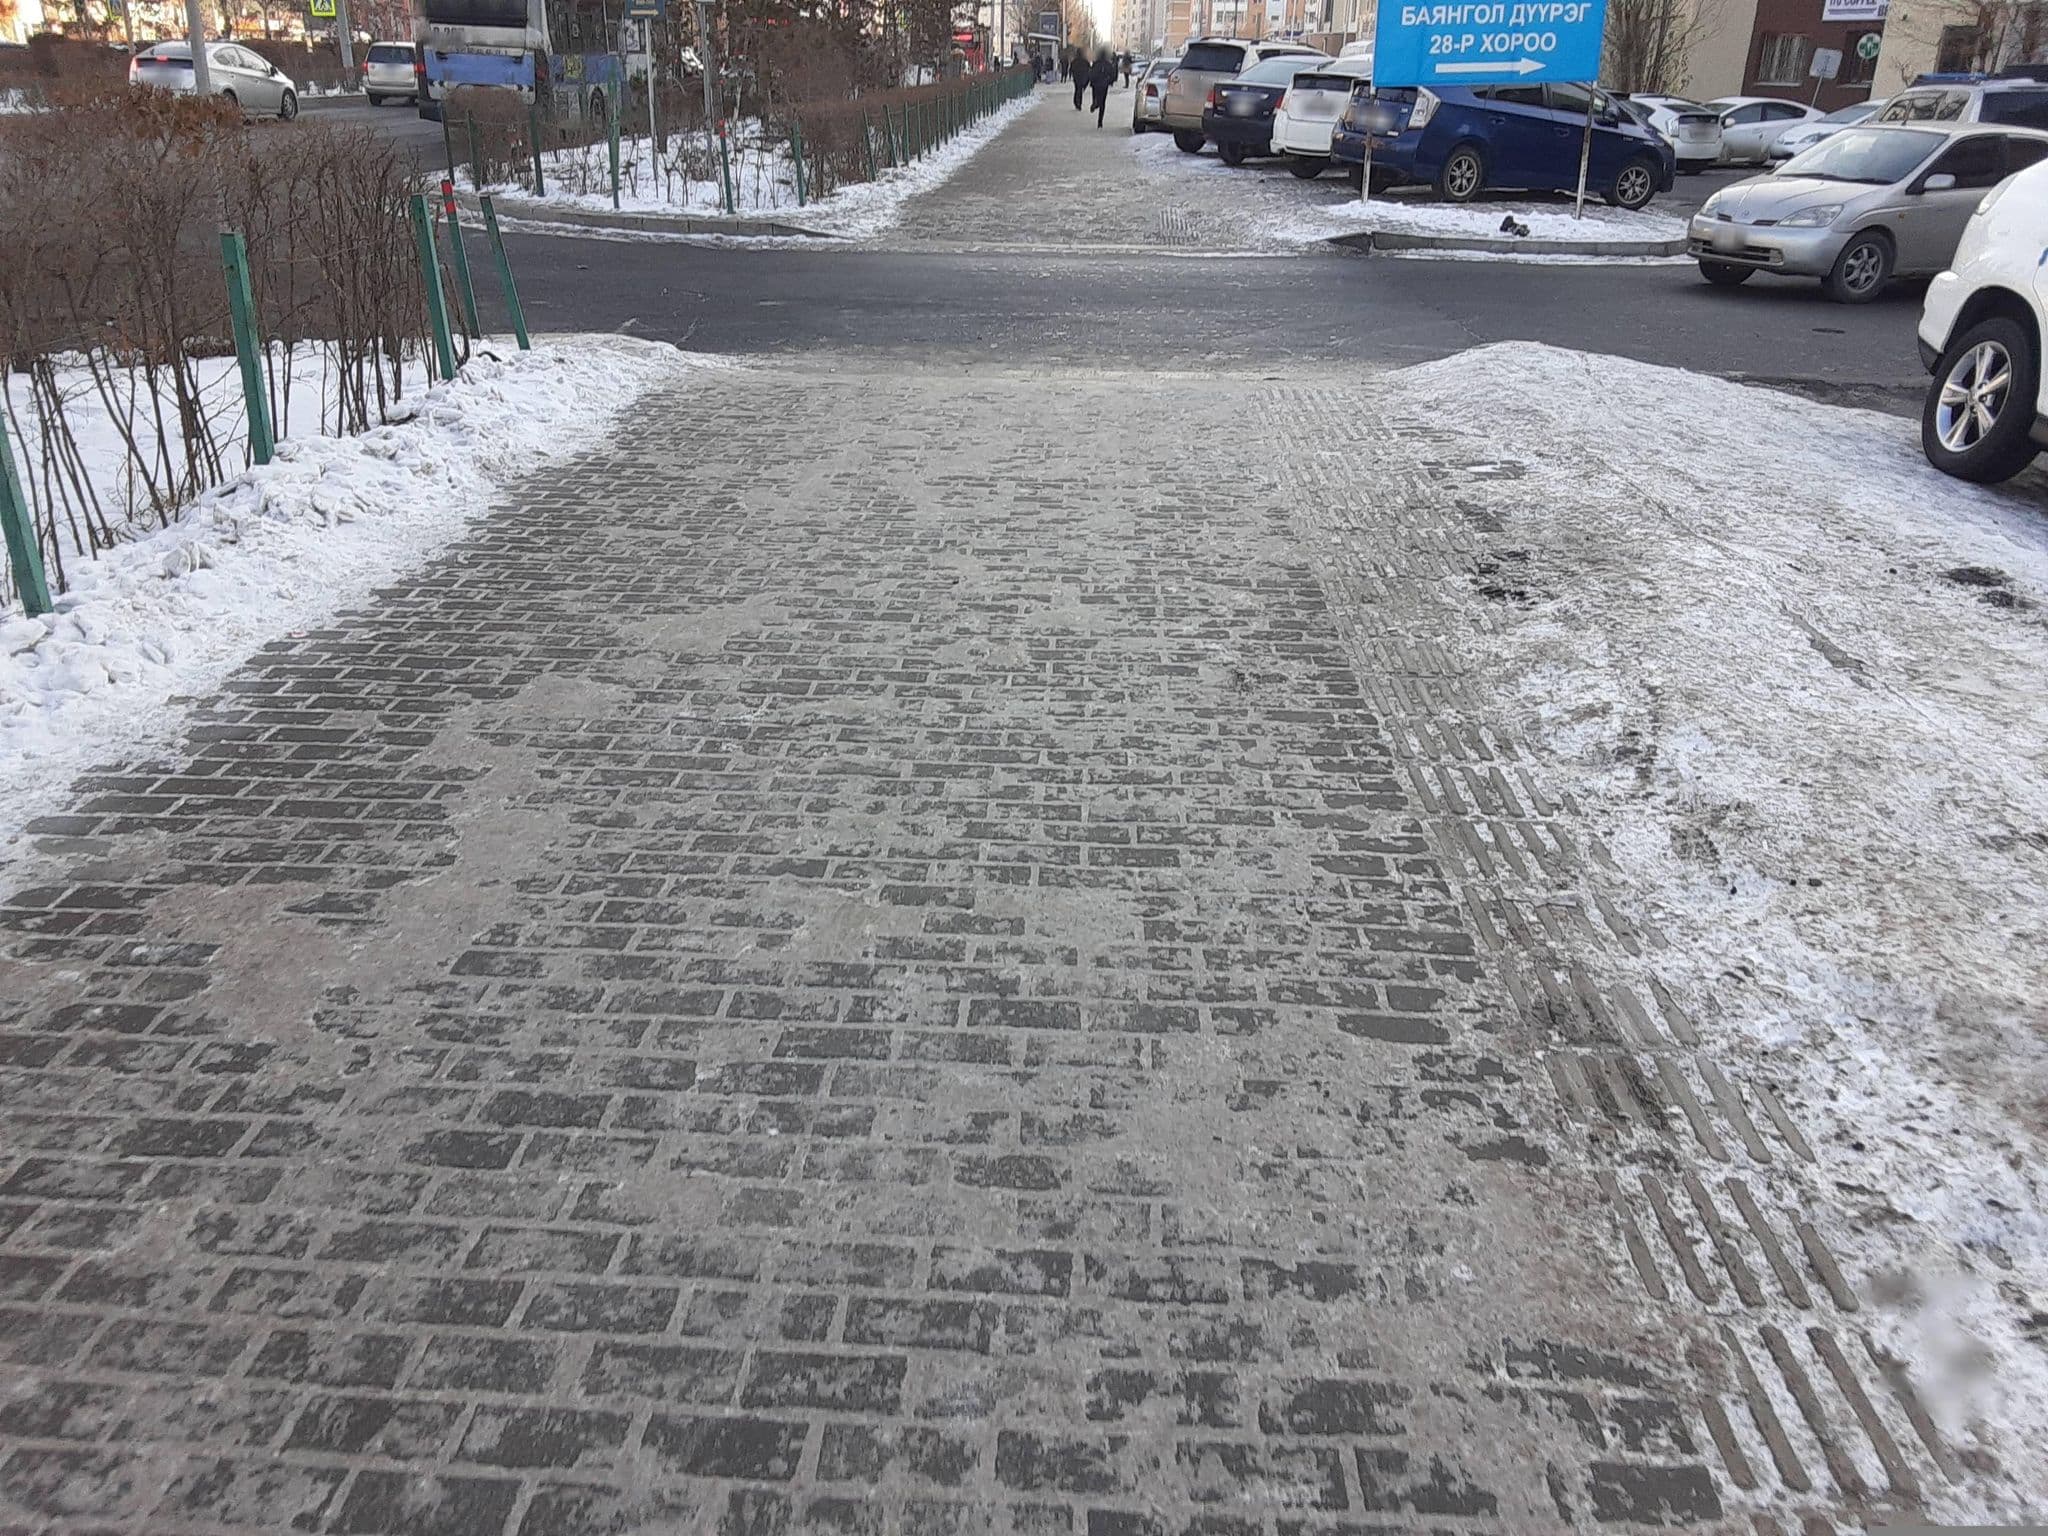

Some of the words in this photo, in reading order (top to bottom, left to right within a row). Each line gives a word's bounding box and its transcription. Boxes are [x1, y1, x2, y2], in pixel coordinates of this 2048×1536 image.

[1401, 5, 1505, 26] БАЯНГОЛ
[1508, 3, 1592, 27] ДҮҮРЭГ
[1428, 34, 1475, 54] 28-Р
[1479, 32, 1557, 53] ХОРОО
